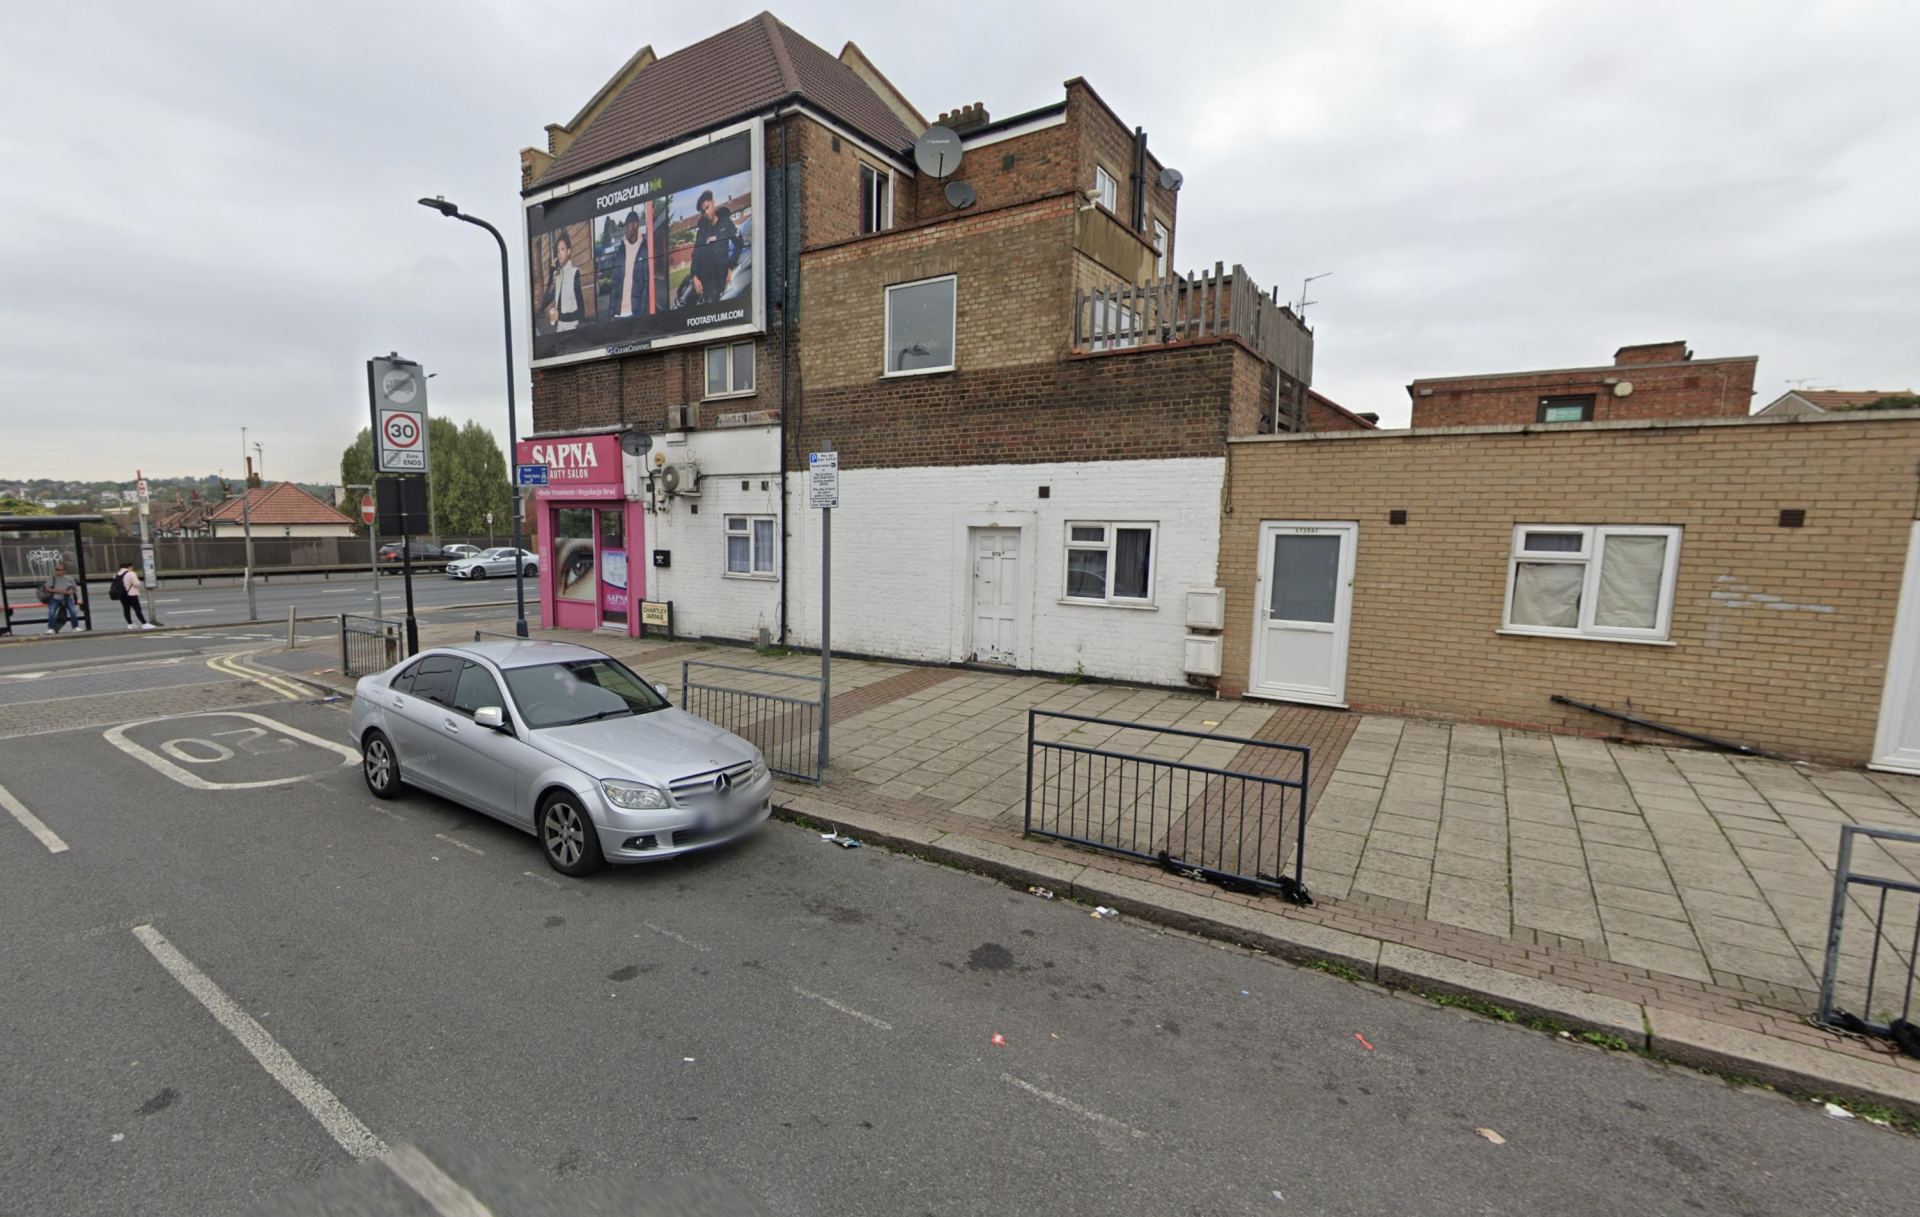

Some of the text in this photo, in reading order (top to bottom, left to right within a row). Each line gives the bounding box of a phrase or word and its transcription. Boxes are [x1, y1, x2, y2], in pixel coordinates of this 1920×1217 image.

[687, 309, 744, 327] FOOTASYLUM.COM
[390, 424, 414, 438] 30
[532, 442, 598, 468] SAPNA
[549, 469, 566, 480] AUTY
[567, 468, 588, 479] SALON
